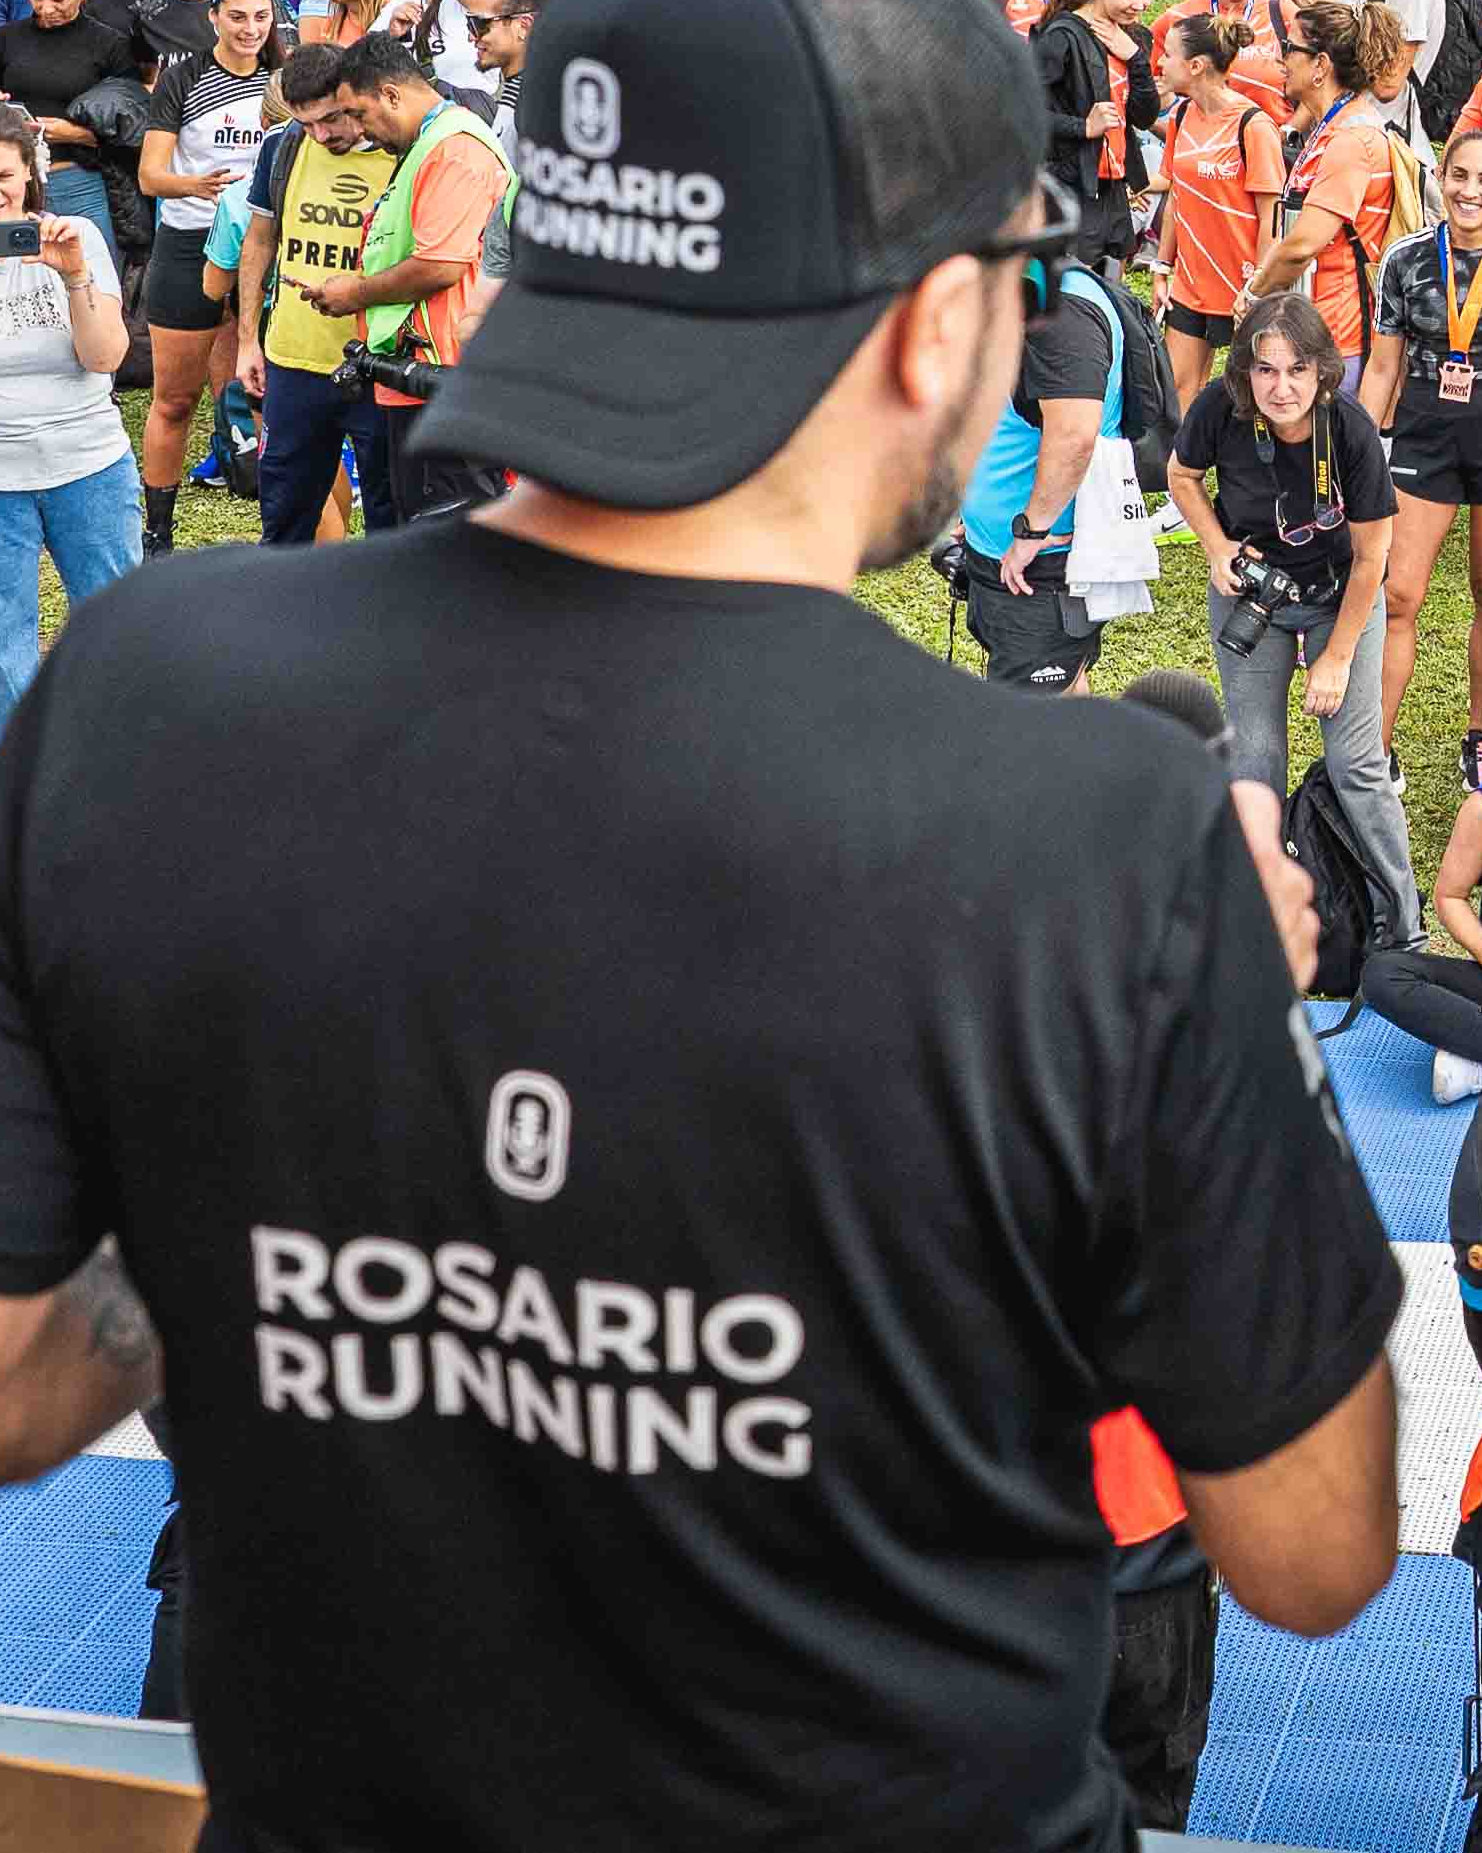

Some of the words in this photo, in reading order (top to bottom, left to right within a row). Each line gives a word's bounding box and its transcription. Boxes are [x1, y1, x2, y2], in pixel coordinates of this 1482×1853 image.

[214, 126, 262, 144] ATENA
[297, 203, 362, 229] SOND
[285, 238, 360, 272] PREN
[1317, 460, 1329, 496] Nikon
[249, 1224, 805, 1386] ROSARIO
[254, 1326, 813, 1480] RUNNING
